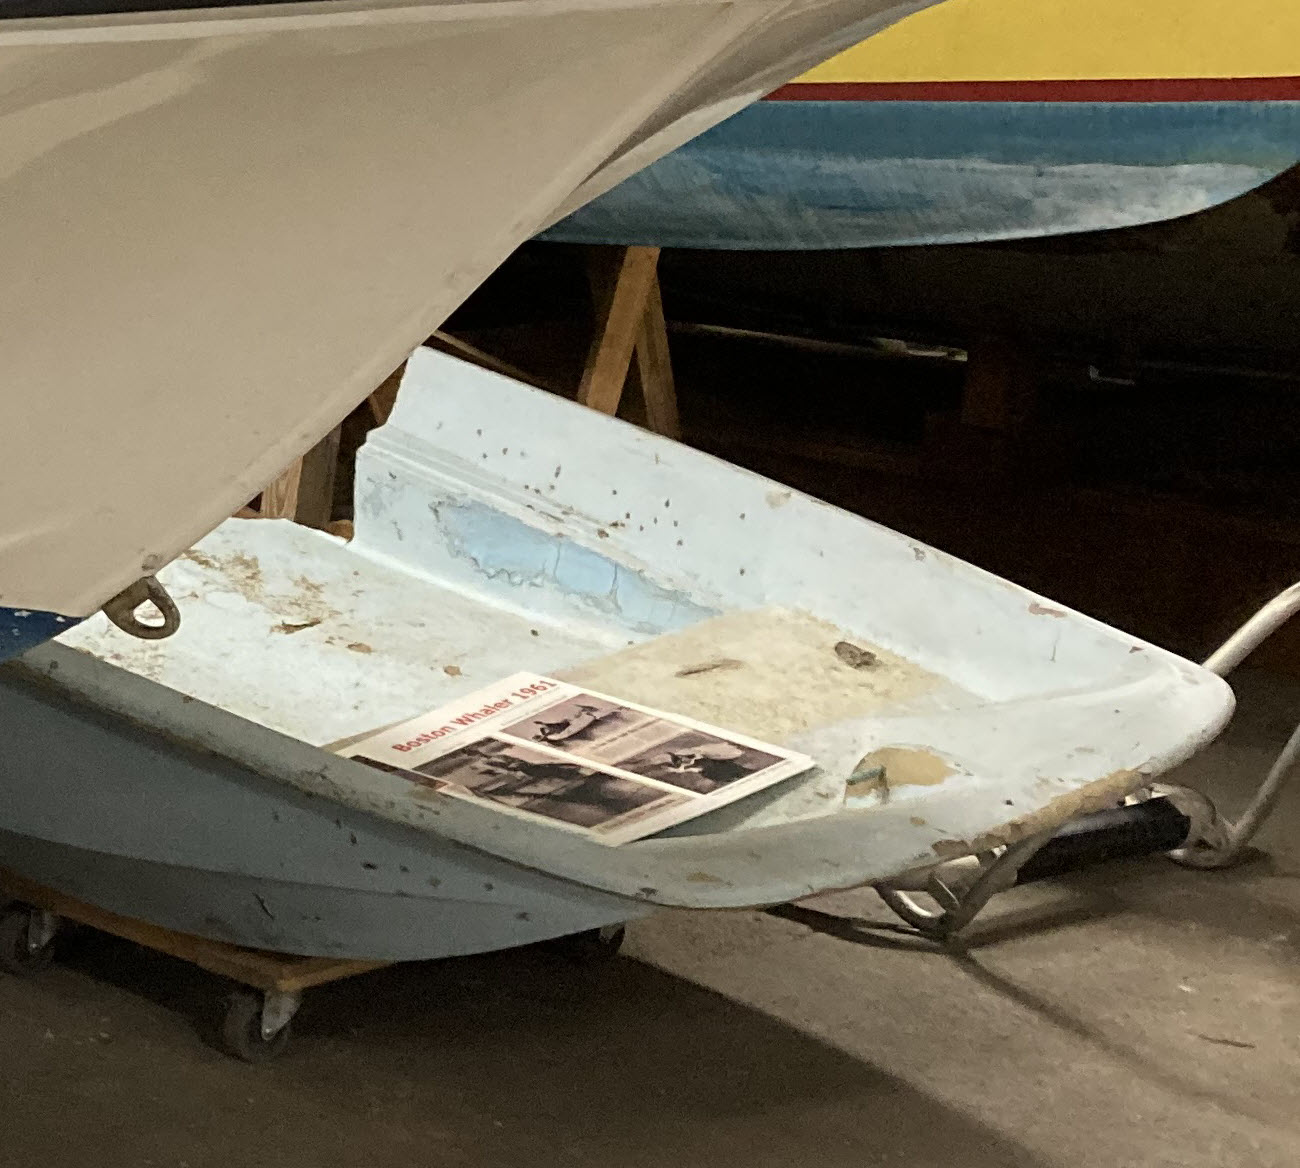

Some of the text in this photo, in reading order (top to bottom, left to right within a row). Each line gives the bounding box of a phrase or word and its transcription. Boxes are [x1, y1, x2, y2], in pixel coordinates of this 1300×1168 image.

[391, 725, 457, 753] Boston
[451, 698, 514, 727] Whaler
[511, 680, 557, 700] 1961
